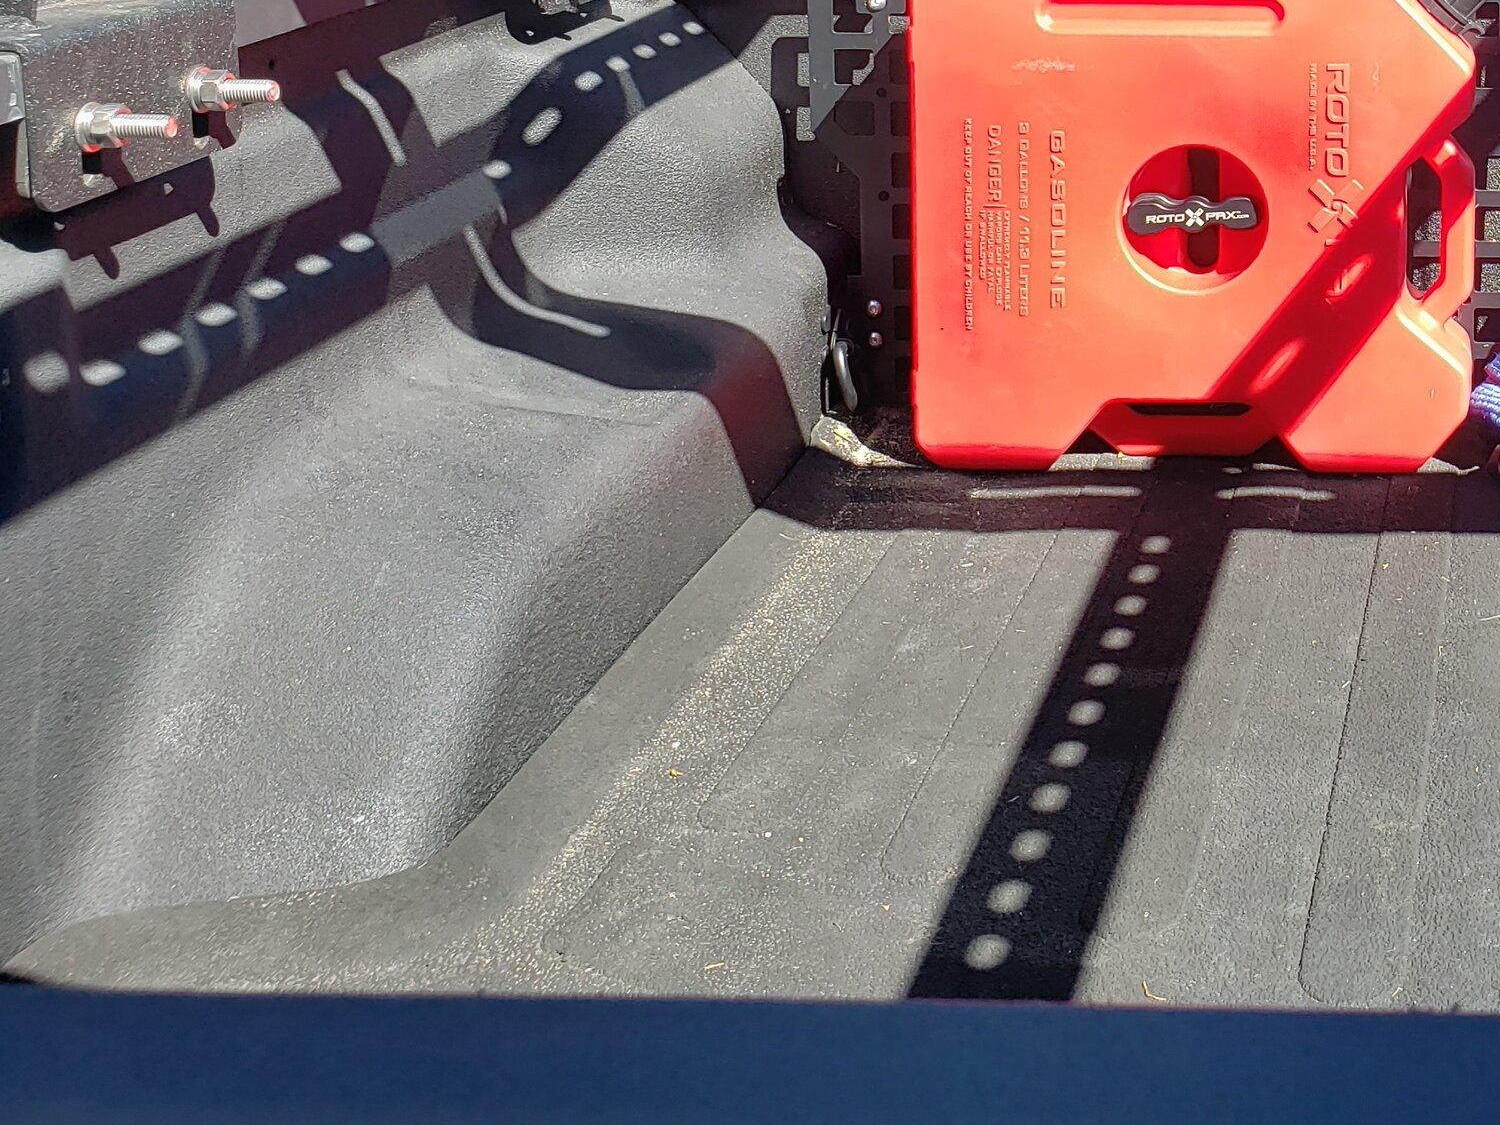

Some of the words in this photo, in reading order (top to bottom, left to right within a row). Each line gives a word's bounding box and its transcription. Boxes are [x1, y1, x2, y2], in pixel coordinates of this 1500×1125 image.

[964, 117, 974, 145] KEEP
[1018, 121, 1030, 134] 3
[964, 147, 973, 167] OUT
[987, 124, 1004, 203] DANGER
[964, 170, 973, 183] OF
[1018, 139, 1030, 210] GALLONS
[964, 186, 973, 220] REACH
[964, 223, 974, 238] OR
[1049, 129, 1067, 310] GASOLINE
[964, 240, 974, 261] USE
[1018, 226, 1030, 260] 11.3
[964, 264, 974, 278] BY
[964, 279, 974, 331] CHILDREN
[1018, 264, 1030, 317] LITERS
